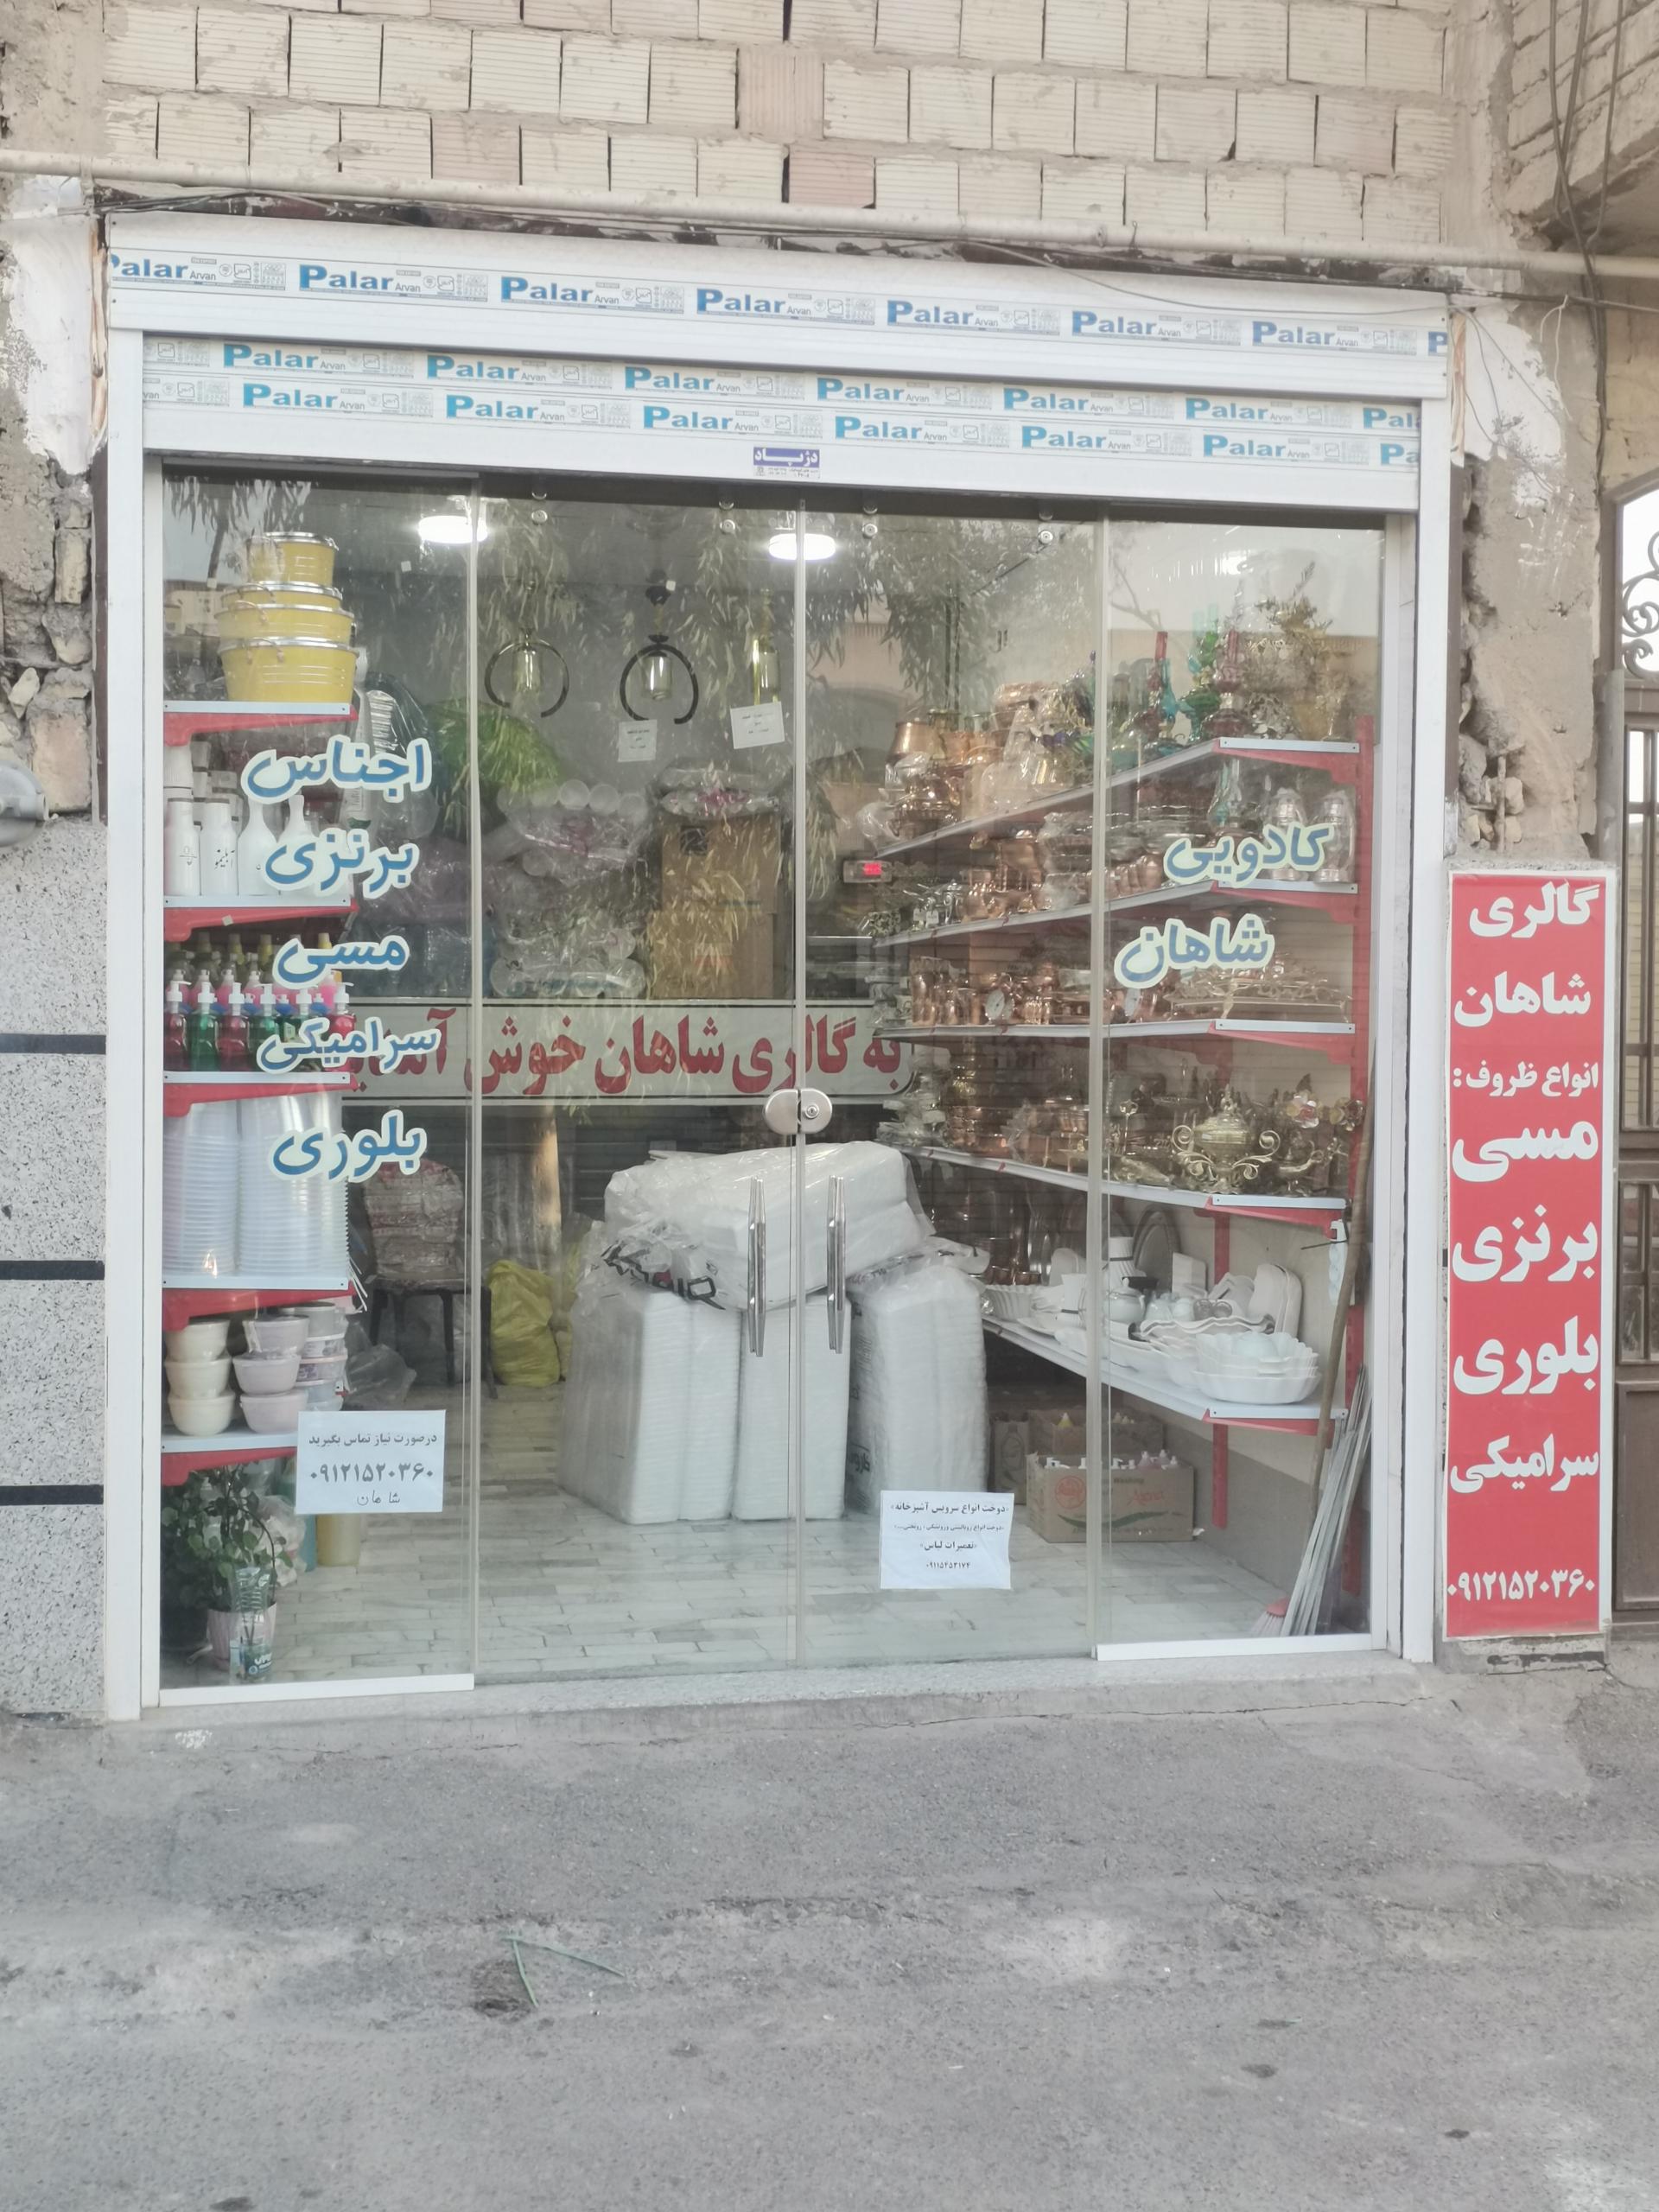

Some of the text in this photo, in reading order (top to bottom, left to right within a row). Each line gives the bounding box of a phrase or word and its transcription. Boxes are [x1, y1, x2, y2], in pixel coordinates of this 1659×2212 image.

[189, 270, 217, 281] Arvan
[299, 264, 393, 290] Palar
[500, 276, 594, 303] Palar
[696, 289, 786, 315] Palar
[887, 300, 975, 326] Palar
[1071, 310, 1158, 336] Palar
[1252, 321, 1335, 346] Palar
[223, 344, 319, 370] Palar
[427, 354, 520, 381] Palar
[624, 366, 715, 392] Palar
[817, 377, 905, 403] Palar
[243, 383, 338, 410] Palar
[446, 395, 538, 421] Palar
[1003, 388, 1090, 413] Palar
[1185, 397, 1268, 422] Palar
[643, 405, 733, 431] Palar
[835, 416, 923, 441] Palar
[1021, 425, 1107, 449] Palar
[1203, 434, 1286, 458] Palar
[245, 737, 427, 800] اجناس
[263, 830, 416, 895] برنزی
[1166, 824, 1332, 885] کادویی
[1469, 880, 1600, 938] گالری
[275, 938, 408, 986] مسی
[1117, 917, 1271, 985] شاهان
[1453, 970, 1591, 1027] شاهان
[258, 1019, 440, 1071] سرامیکی
[464, 1014, 586, 1095] خوش
[594, 1014, 725, 1094] شاهان
[862, 1036, 901, 1091] به
[1541, 1061, 1599, 1096] انواع
[270, 1112, 423, 1182] بلوری
[1452, 1120, 1599, 1182] مسی
[1452, 1204, 1599, 1283] برنزی
[1452, 1314, 1599, 1395] بلوری
[343, 1433, 371, 1446] تماس
[373, 1433, 391, 1446] نیاز
[310, 1462, 434, 1483] ۰۹۱۲۱۵۲۰۳۶۰
[1450, 1433, 1599, 1494] سرامیکی
[1446, 1567, 1596, 1601] ۰۹۱۲۱۵۲۰۳۶۰
